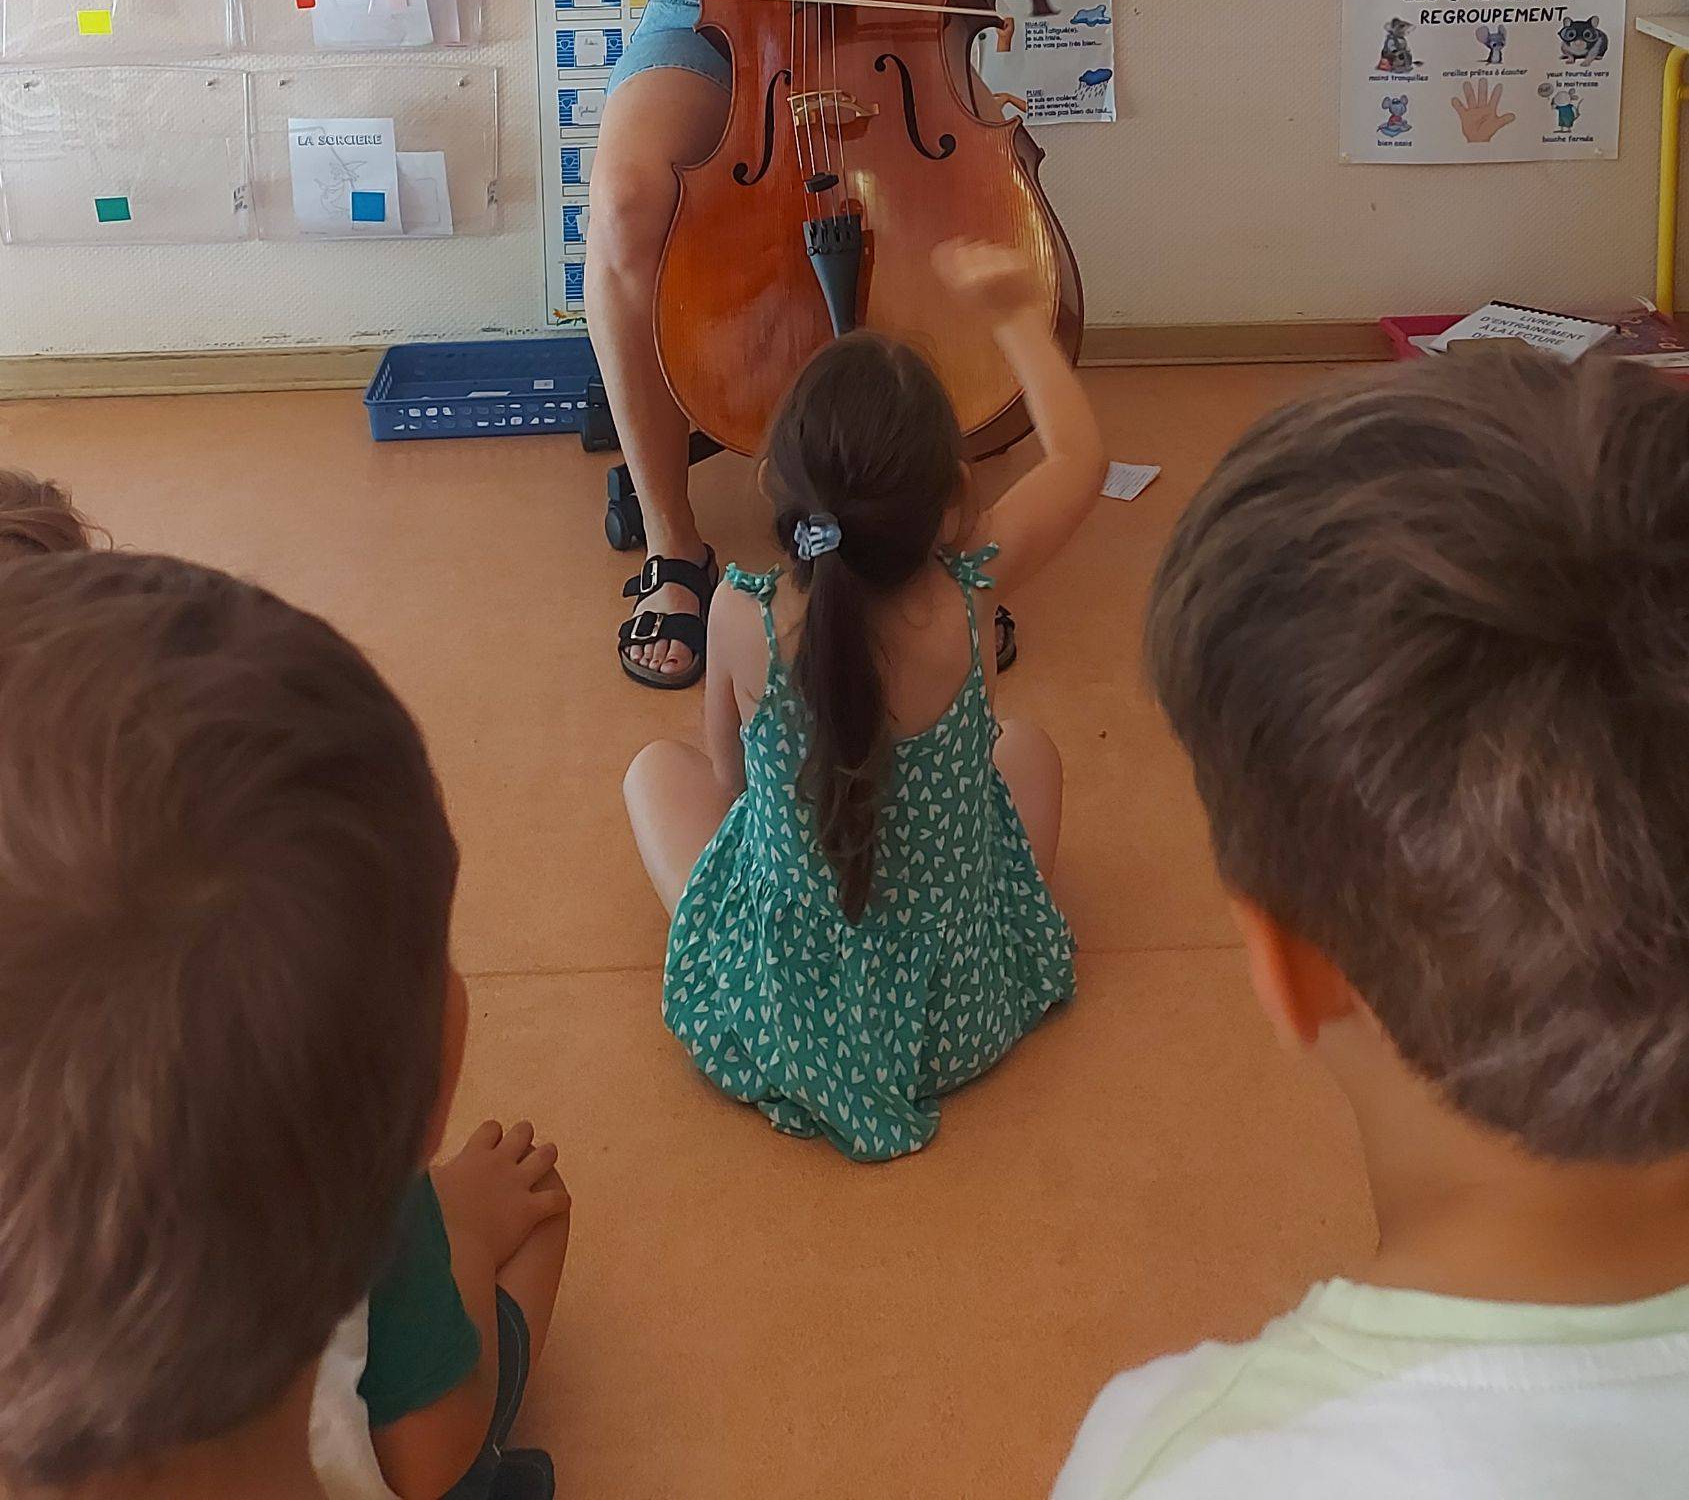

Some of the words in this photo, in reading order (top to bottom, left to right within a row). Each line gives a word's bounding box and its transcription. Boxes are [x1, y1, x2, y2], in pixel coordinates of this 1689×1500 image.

[1420, 7, 1567, 25] REGROUPEMENT
[298, 135, 313, 146] LA
[1520, 316, 1564, 327] LIVRET
[1508, 330, 1565, 345] LECTURE
